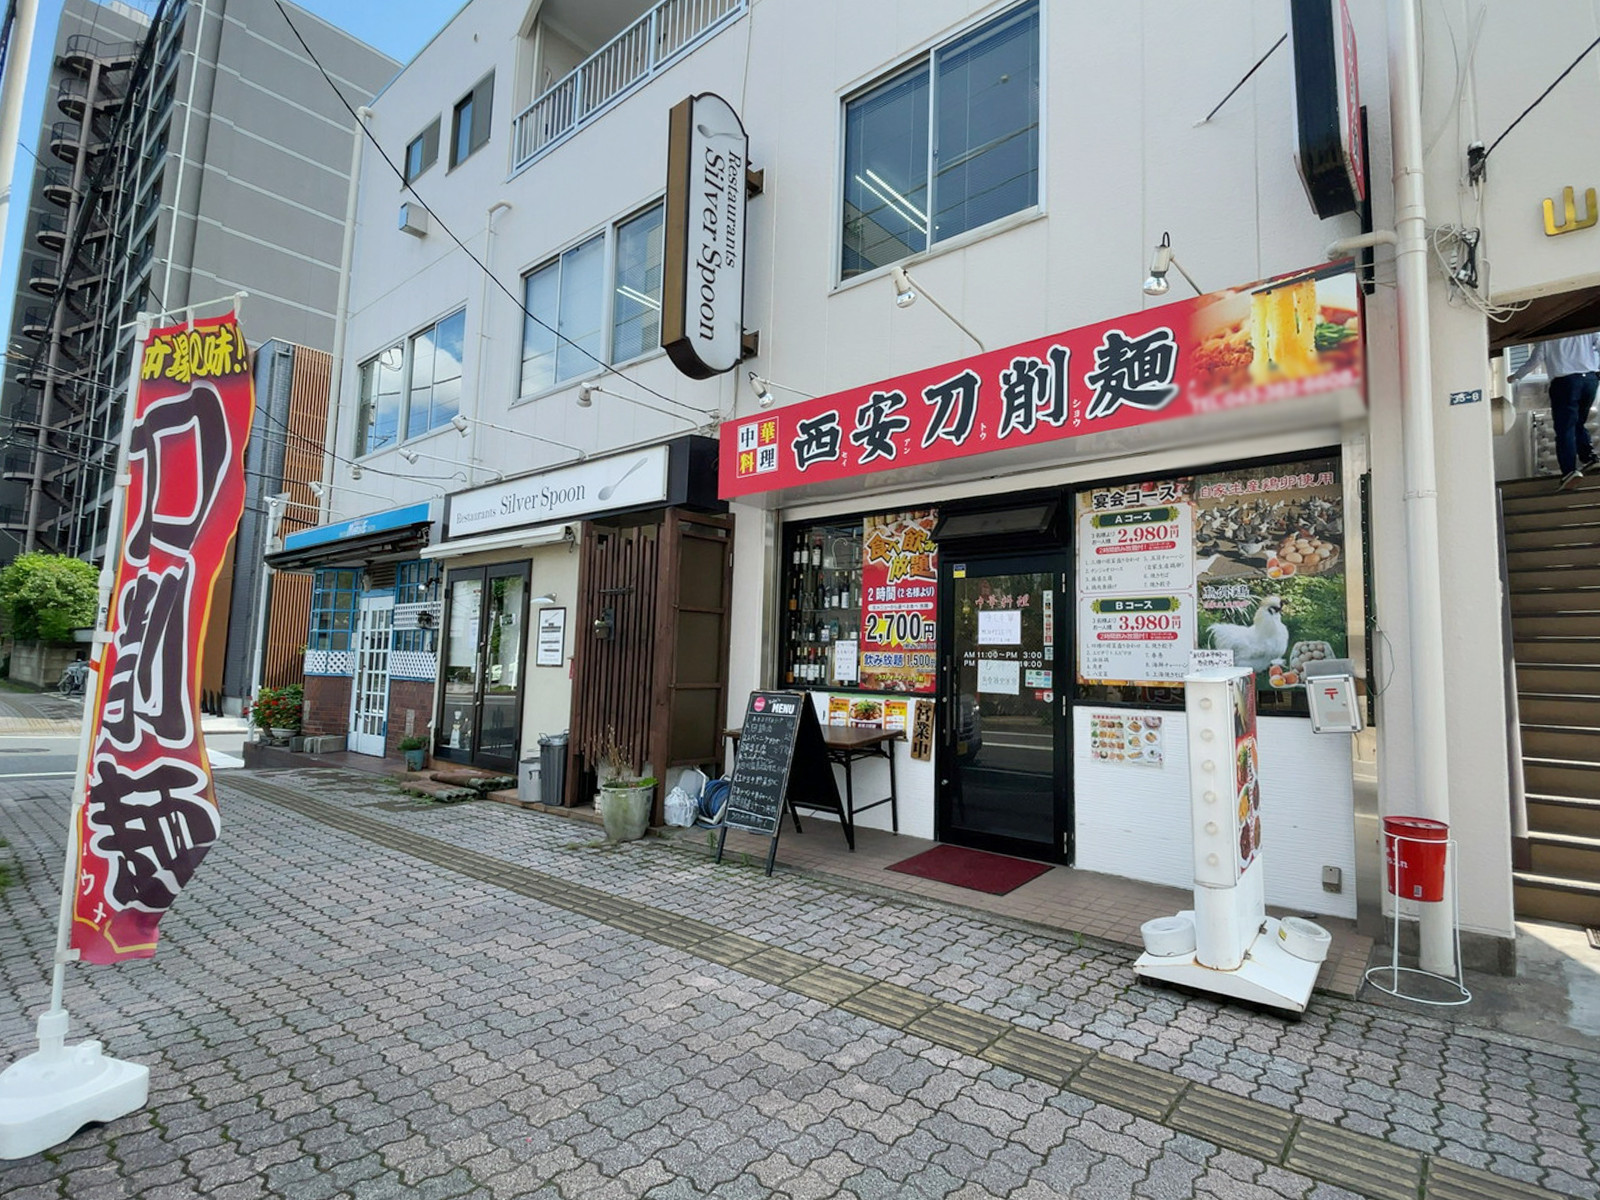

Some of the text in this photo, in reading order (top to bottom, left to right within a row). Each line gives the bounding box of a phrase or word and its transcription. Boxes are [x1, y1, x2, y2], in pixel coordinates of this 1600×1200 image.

[725, 150, 741, 268] Restaurants
[696, 146, 725, 341] Silver Spoon
[1072, 398, 1081, 428] ショウ
[979, 422, 987, 440] トウ
[903, 438, 911, 454] アン
[1093, 485, 1175, 509] 宴会コース
[1200, 472, 1334, 498] 自家生産鶏卵使用
[456, 484, 586, 524] Restaurants Silver Spoon
[888, 552, 937, 583] 放題
[863, 652, 904, 667] 飲み放題
[963, 651, 976, 659] AM
[1022, 651, 1043, 659] 3:00
[771, 702, 796, 715] MENU
[913, 702, 931, 758] 営業中
